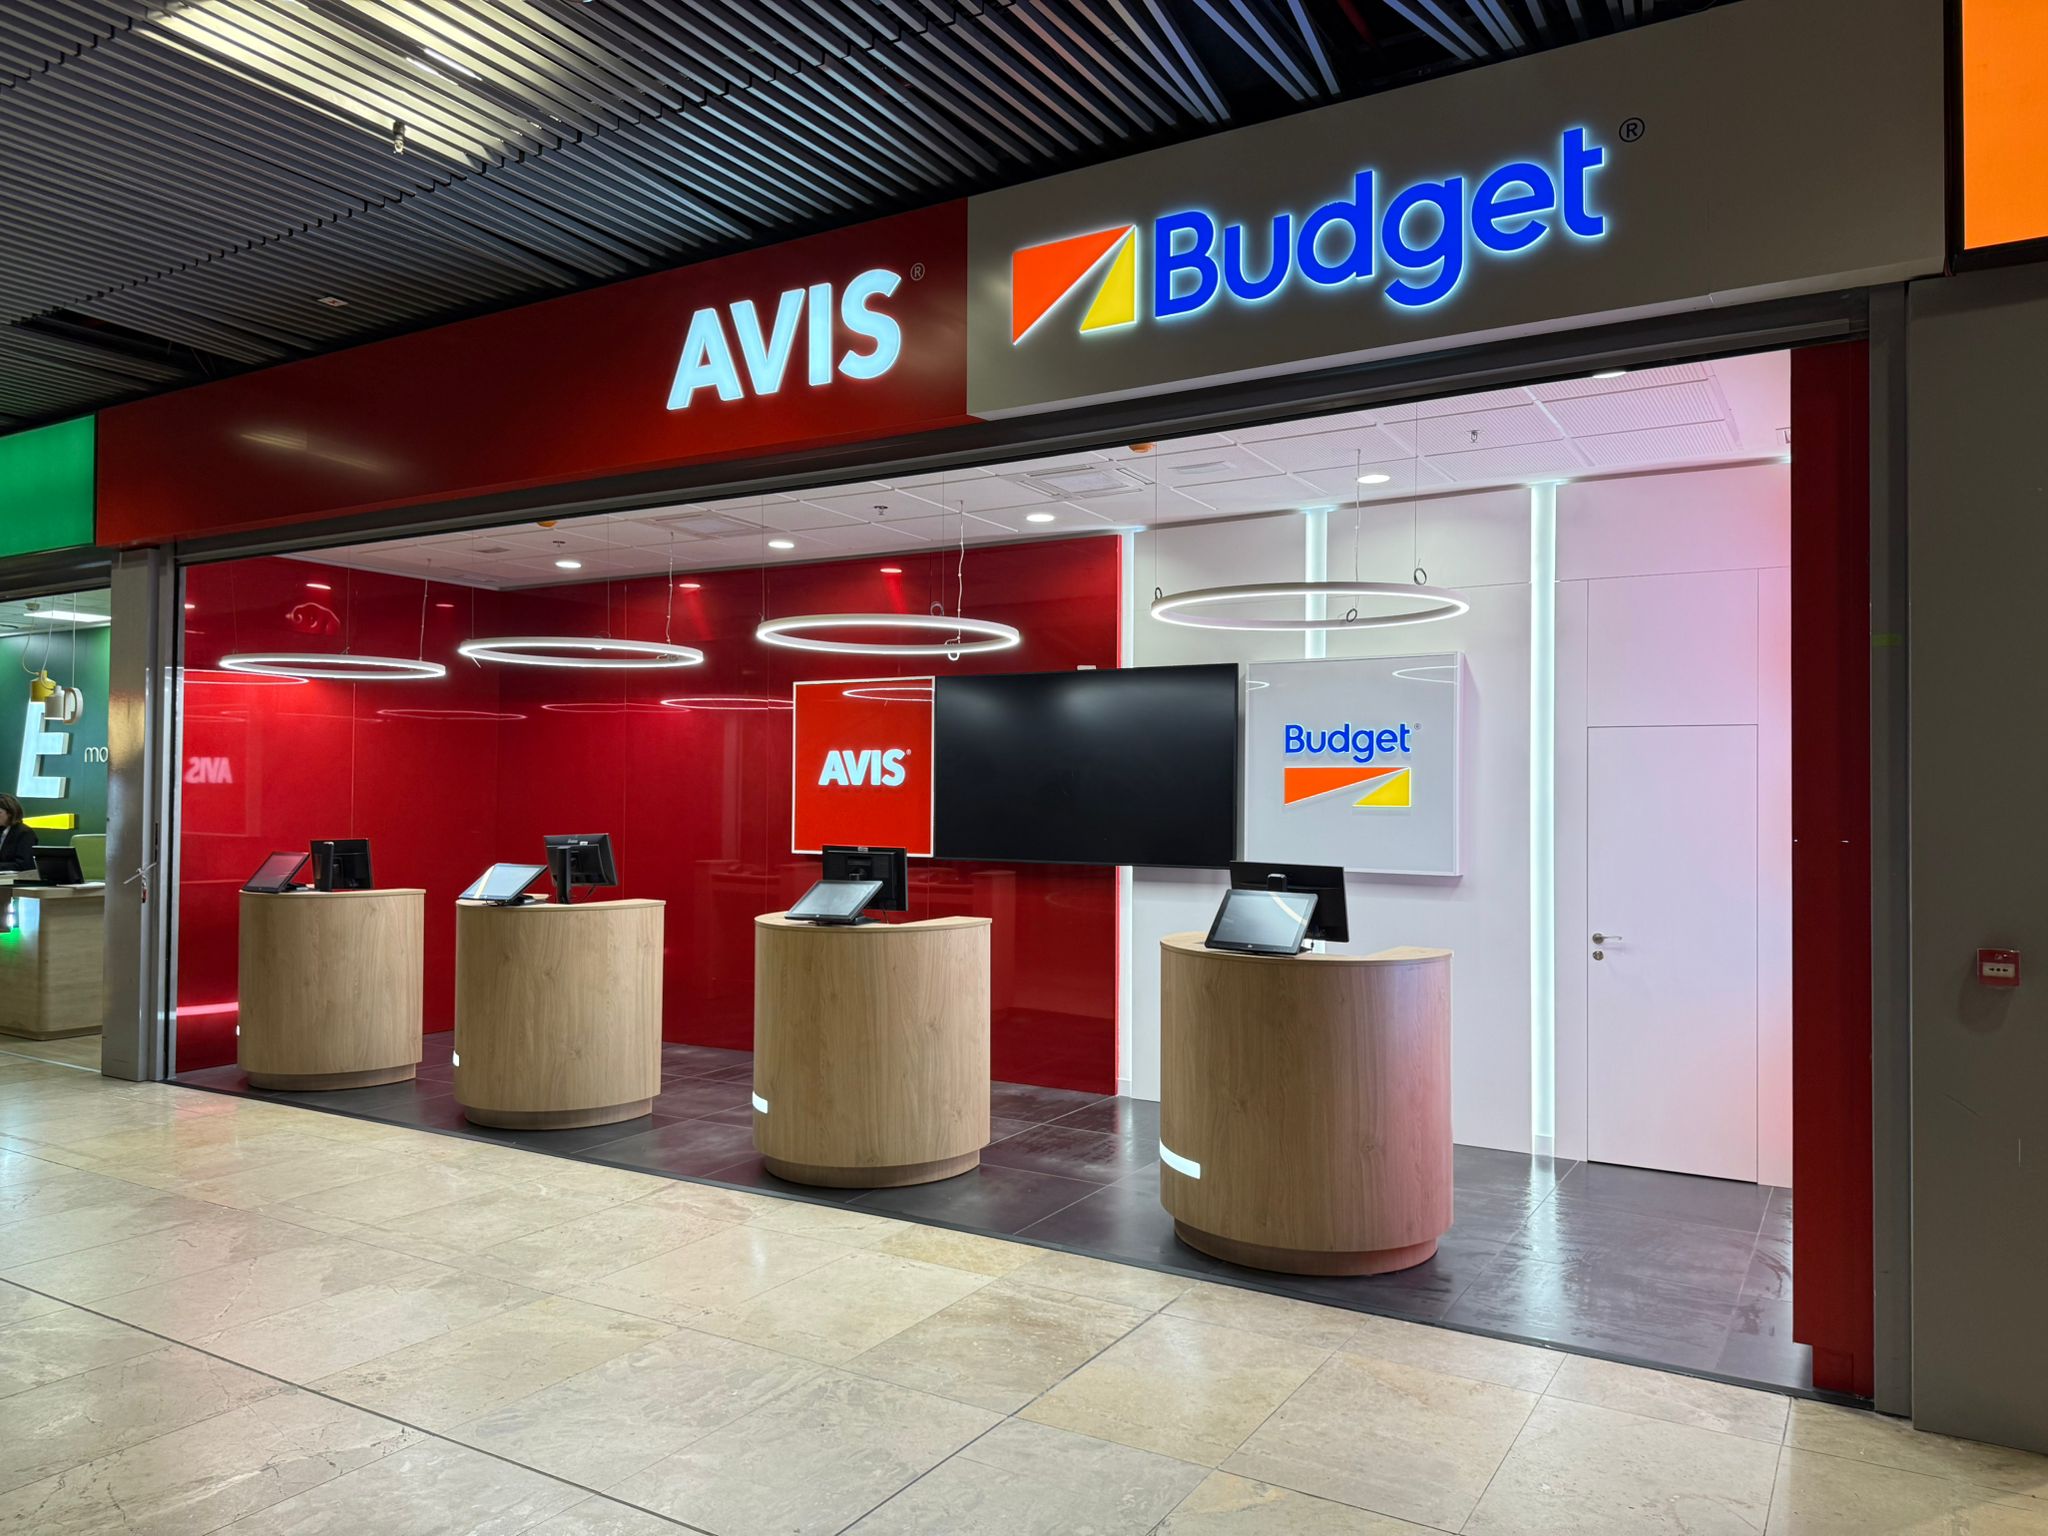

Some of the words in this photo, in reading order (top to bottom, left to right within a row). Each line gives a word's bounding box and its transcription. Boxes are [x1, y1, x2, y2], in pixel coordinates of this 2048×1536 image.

[1154, 126, 1606, 319] Budget
[667, 268, 902, 411] AVIS
[818, 748, 906, 786] AVIS
[1284, 722, 1411, 763] Budget
